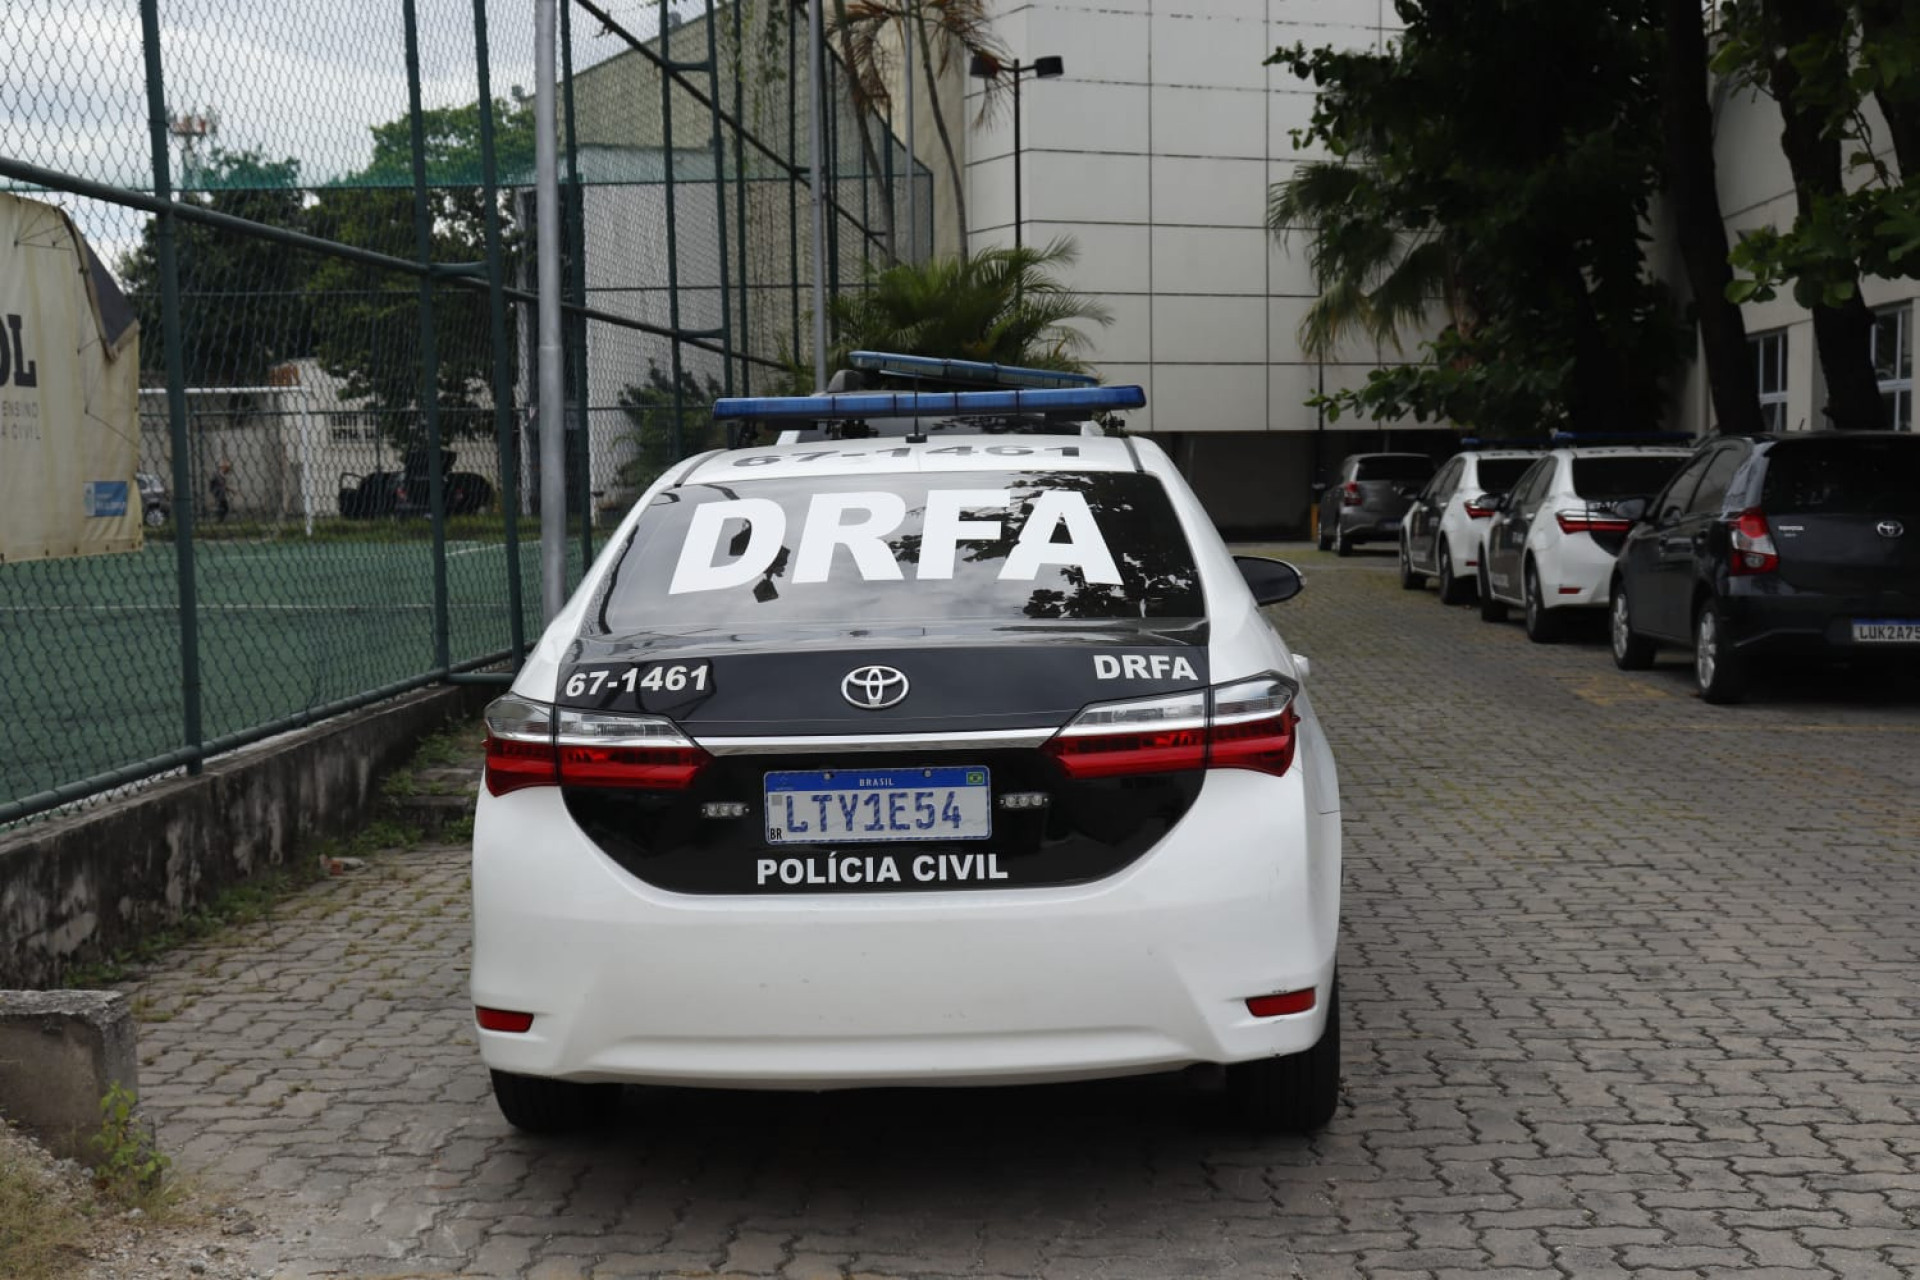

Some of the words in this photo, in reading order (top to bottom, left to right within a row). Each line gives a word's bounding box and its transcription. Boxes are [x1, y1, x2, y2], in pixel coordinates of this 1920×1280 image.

[733, 446, 1080, 467] 67-1461
[669, 489, 1124, 594] DRFA
[566, 665, 709, 697] 67-1461
[1093, 654, 1199, 680] DRFA
[859, 778, 895, 787] BRASIL
[786, 791, 962, 833] LTY1E54
[770, 828, 783, 840] BR
[757, 851, 902, 885] POLÍCIA
[912, 853, 1009, 882] CIVIL
